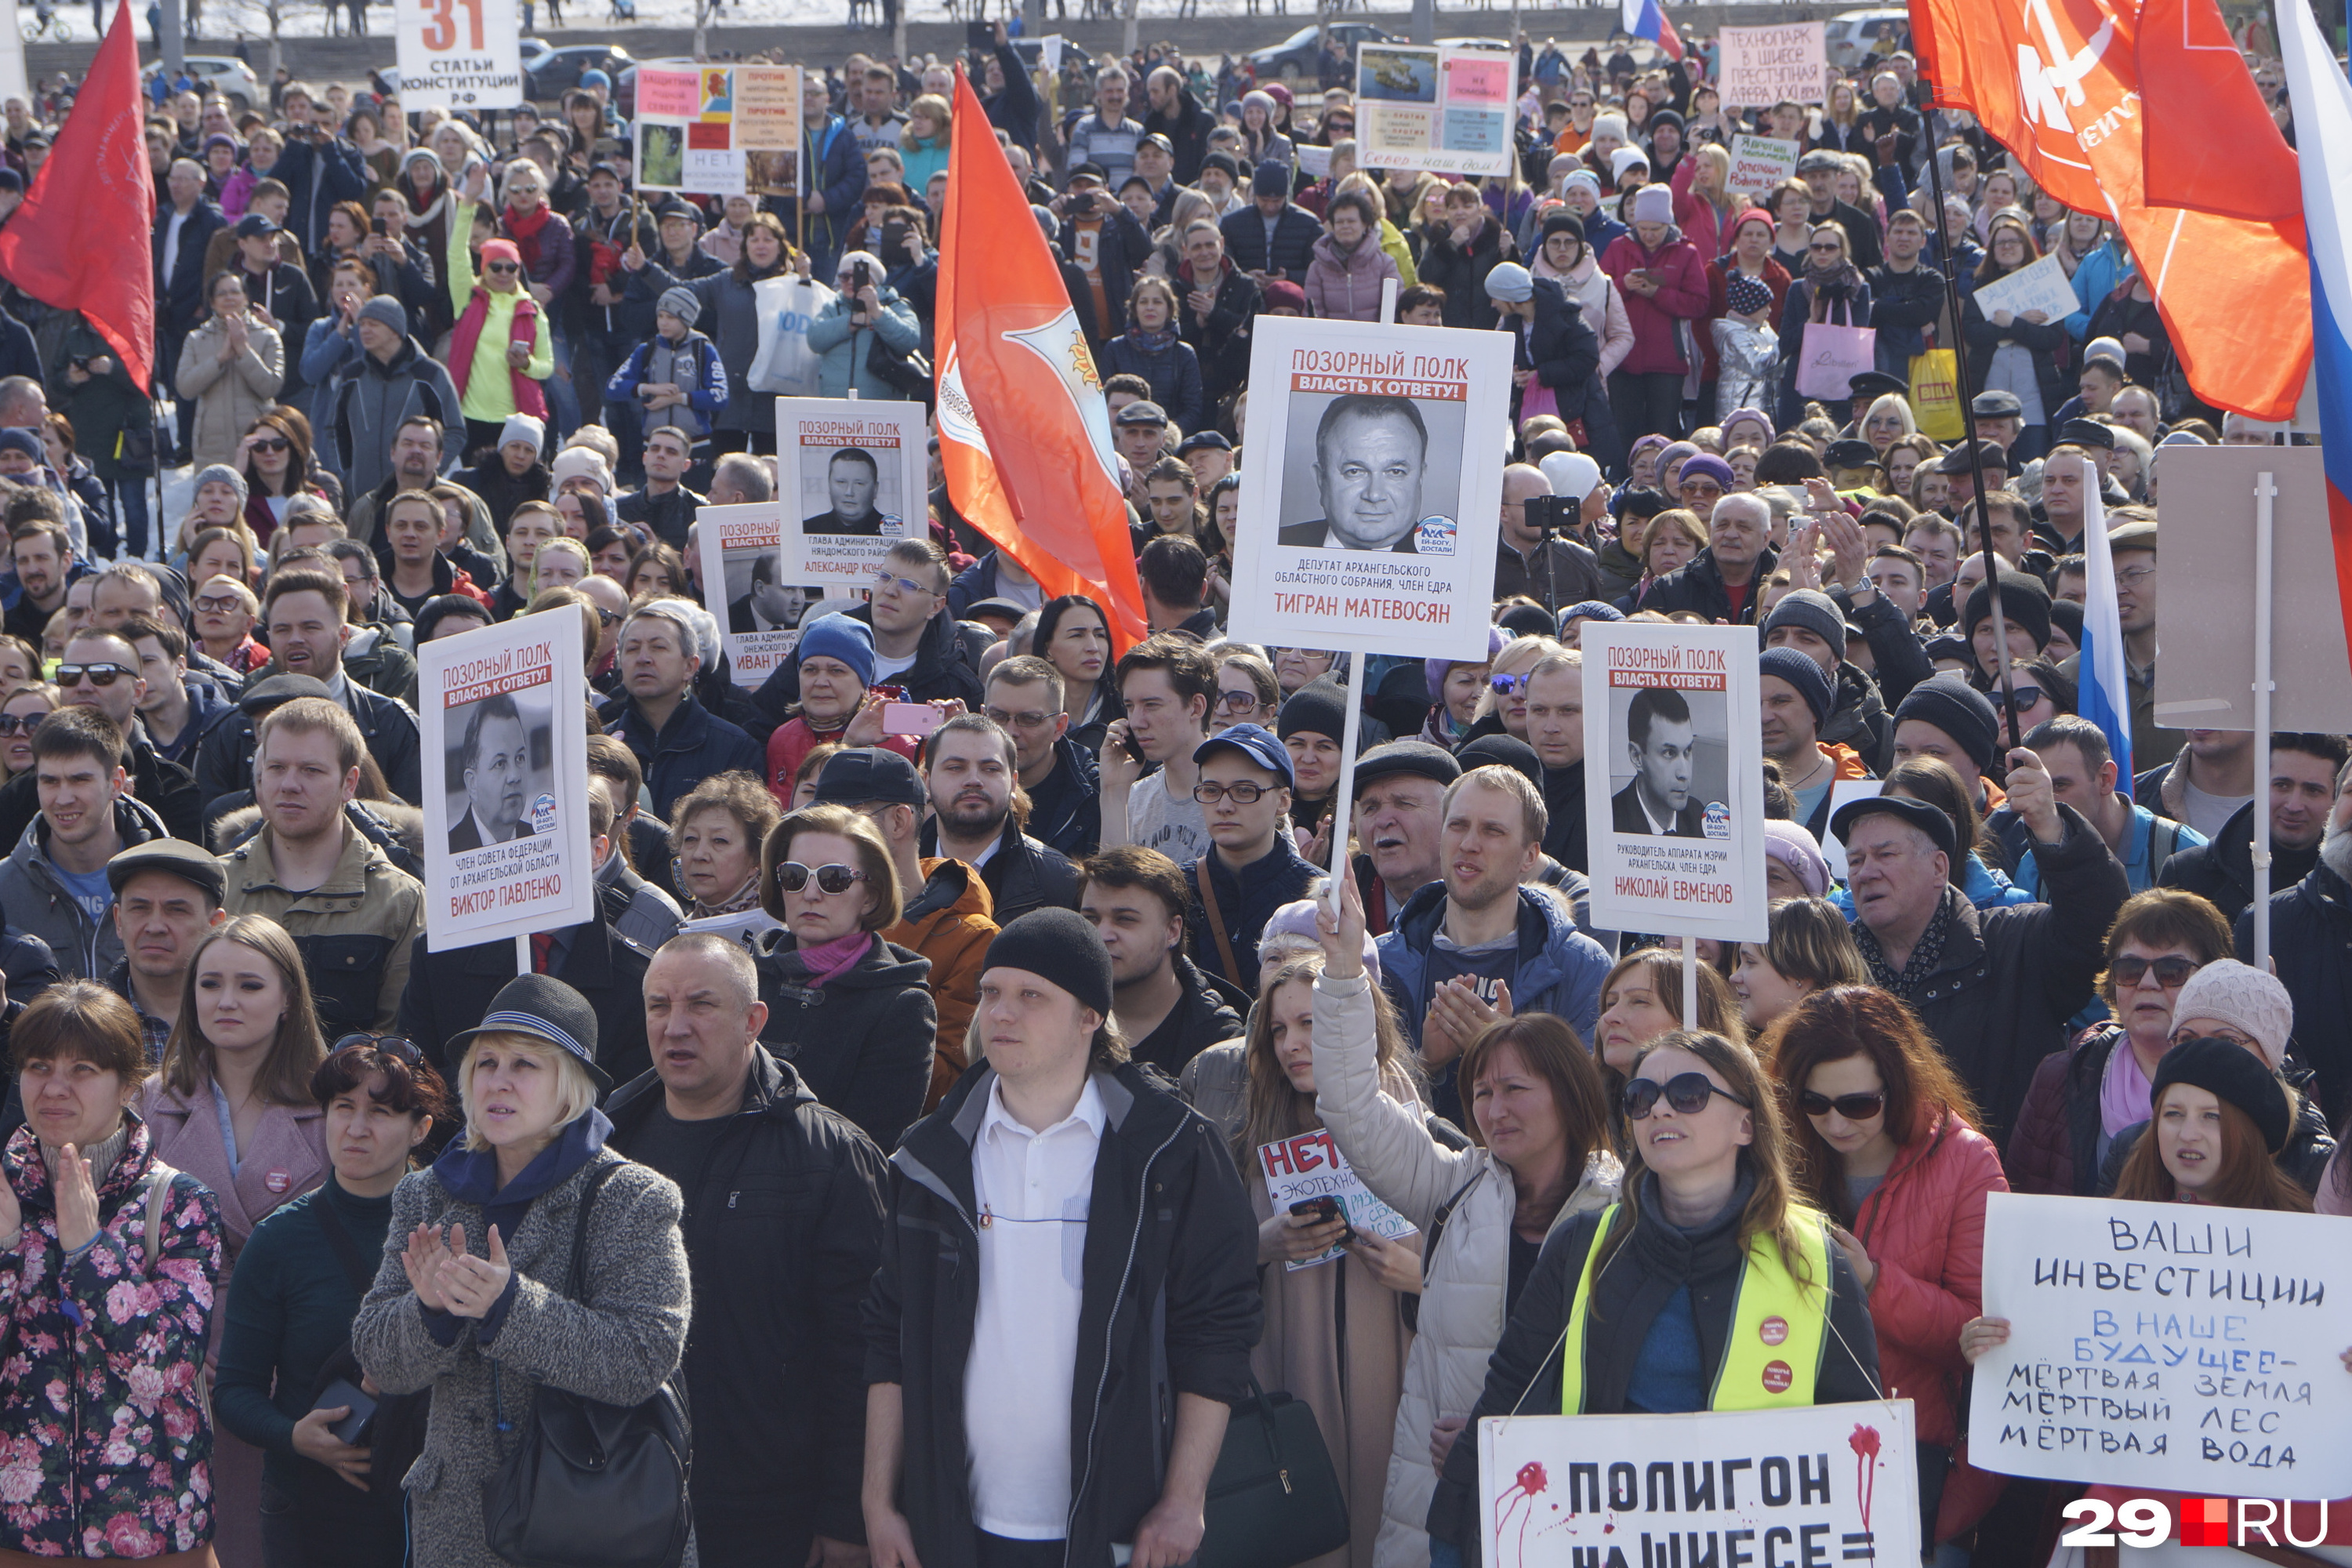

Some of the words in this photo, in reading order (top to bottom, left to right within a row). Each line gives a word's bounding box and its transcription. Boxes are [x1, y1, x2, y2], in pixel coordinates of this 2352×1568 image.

[1730, 27, 1813, 48] ТЕХНОПАРК
[430, 60, 493, 73] СТАТЬИ
[1741, 50, 1751, 66] В
[401, 75, 518, 91] КОНСТИТУЦИИ
[748, 72, 786, 82] ПРОТИВ
[1731, 64, 1818, 85] ПРЕСТУПНАЯ
[452, 93, 477, 103] РФ
[1730, 86, 1772, 103] АФЕРА
[747, 107, 786, 116] ПРОТИВ
[695, 154, 734, 166] НЕТ
[1292, 350, 1405, 376] ПОЗОРНЫЙ
[1414, 355, 1469, 380] ПОЛК
[1299, 376, 1368, 392] ВЛАСТЬ
[1372, 379, 1385, 394] К
[1387, 380, 1459, 398] ОТВЕТУ!
[799, 419, 863, 434] ПОЗОРНЫЙ
[868, 422, 901, 436] ПОЛК
[804, 436, 844, 445] ВЛАСТЬ
[855, 437, 897, 447] ОТВЕТУ!
[720, 519, 780, 537] ПОЗОРНЫЙ
[725, 537, 764, 547] ВЛАСТЬ
[808, 536, 832, 545] ГЛАВА
[811, 547, 865, 557] НЯНДОМСКОГО
[804, 561, 858, 575] АЛЕКСАНДР
[1298, 559, 1342, 572] ДЕПУТАТ
[1345, 561, 1431, 577] АРХАНГЕЛЬСКОГО
[1275, 572, 1338, 586] ОБЛАСТНОГО
[1341, 575, 1396, 590] СОБРАНИЯ,
[1399, 580, 1424, 592] ЧЛЕН
[1428, 581, 1452, 594] ЕДРА
[1274, 592, 1338, 616] ТИГРАН
[1344, 597, 1450, 624] МАТЕВОСЯН
[736, 635, 759, 644] ГЛАВА
[744, 642, 786, 653] ОНЕЖСКОГО
[443, 648, 511, 688] ПОЗОРНЫЙ
[517, 641, 552, 670] ПОЛК
[736, 654, 770, 670] ИВАН
[1608, 644, 1681, 670] ПОЗОРНЫЙ
[1686, 649, 1726, 670] ПОЛК
[448, 684, 492, 705] ВЛАСТЬ
[493, 681, 500, 694] К
[502, 668, 547, 691] ОТВЕТУ!
[1613, 672, 1658, 685] ВЛАСТЬ
[1660, 673, 1669, 686] К
[1670, 674, 1721, 688] ОТВЕТУ!
[456, 856, 475, 870] ЧЛЕН
[477, 849, 506, 866] СОВЕТА
[508, 837, 553, 859] ФЕДЕРАЦИИ
[1617, 844, 1666, 858] РУКОВОДИТЕЛЬ
[1668, 848, 1702, 860] АППАРАТА
[1704, 850, 1728, 862] МЭРИИ
[450, 876, 460, 889] ОТ
[463, 859, 523, 887] АРХАНГЕЛЬСКОЙ
[525, 853, 560, 873] ОБЛАСТИ
[1628, 858, 1678, 873] АРХАНГЕЛЬСКА,
[1679, 862, 1697, 873] ЧЛЕН
[1700, 862, 1717, 876] ЕДРА
[451, 888, 495, 917] ВИКТОР
[499, 873, 561, 906] ПАВЛЕНКО
[1615, 876, 1668, 899] НИКОЛАЙ
[1674, 880, 1733, 904] ЕВМЕНОВ
[1263, 1133, 1339, 1178] НЕТ
[1280, 1172, 1361, 1200] ЭКОТЕХНО
[2107, 1216, 2252, 1258] ВАШИ
[2034, 1257, 2325, 1310] ИНВЕСТИЦИИ
[2093, 1309, 2120, 1338] В
[2136, 1312, 2248, 1341] НАШЕ
[2005, 1358, 2160, 1391] МЁРТВАЯ
[2194, 1374, 2312, 1406] ЗЕМЛЯ
[2001, 1388, 2171, 1421] МЁРТВЫЙ
[2199, 1406, 2280, 1434] ЛЕС
[1999, 1418, 2168, 1456] МЁРТВАЯ
[2201, 1436, 2297, 1470] ВОДА
[1569, 1453, 1831, 1514] ПОЛИГОН
